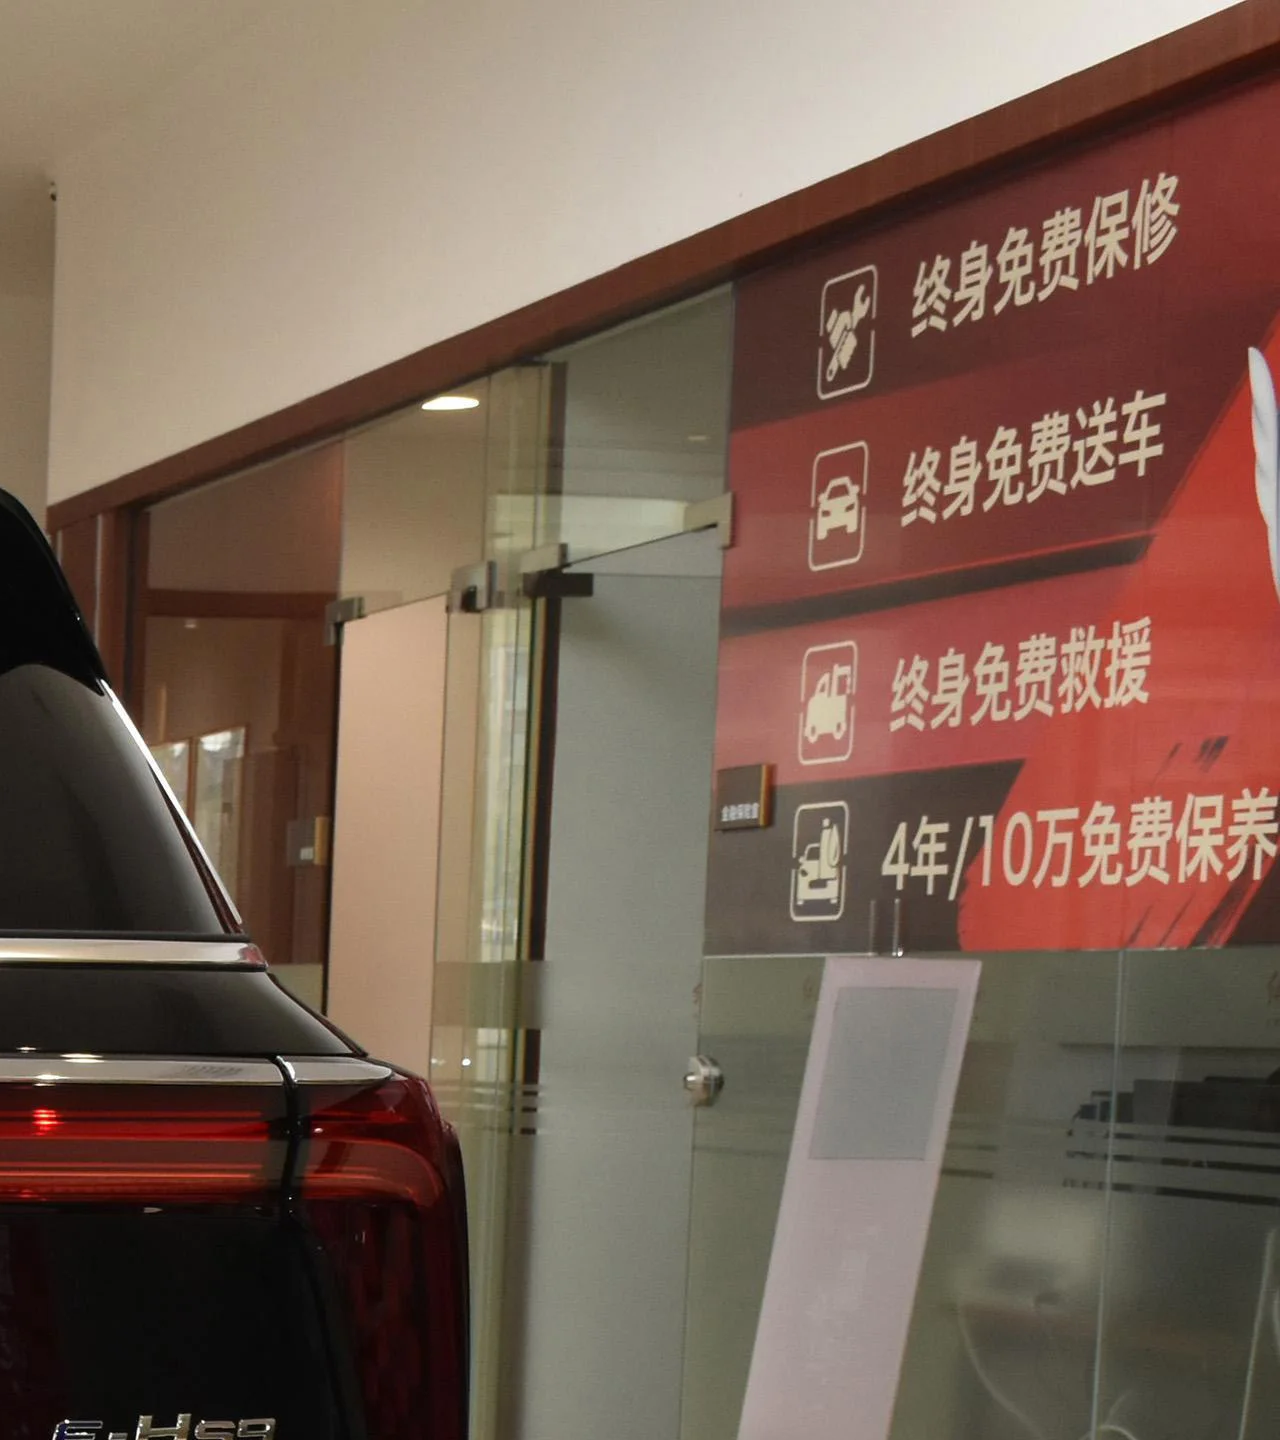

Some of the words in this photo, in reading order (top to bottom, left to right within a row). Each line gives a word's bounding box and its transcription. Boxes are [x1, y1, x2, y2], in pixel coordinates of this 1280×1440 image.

[910, 171, 1181, 338] 终身免费保修
[900, 389, 1167, 527] 终身免费送车
[889, 616, 1151, 733] 终身免费救援
[881, 786, 1279, 901] 4年/10万免费保养
